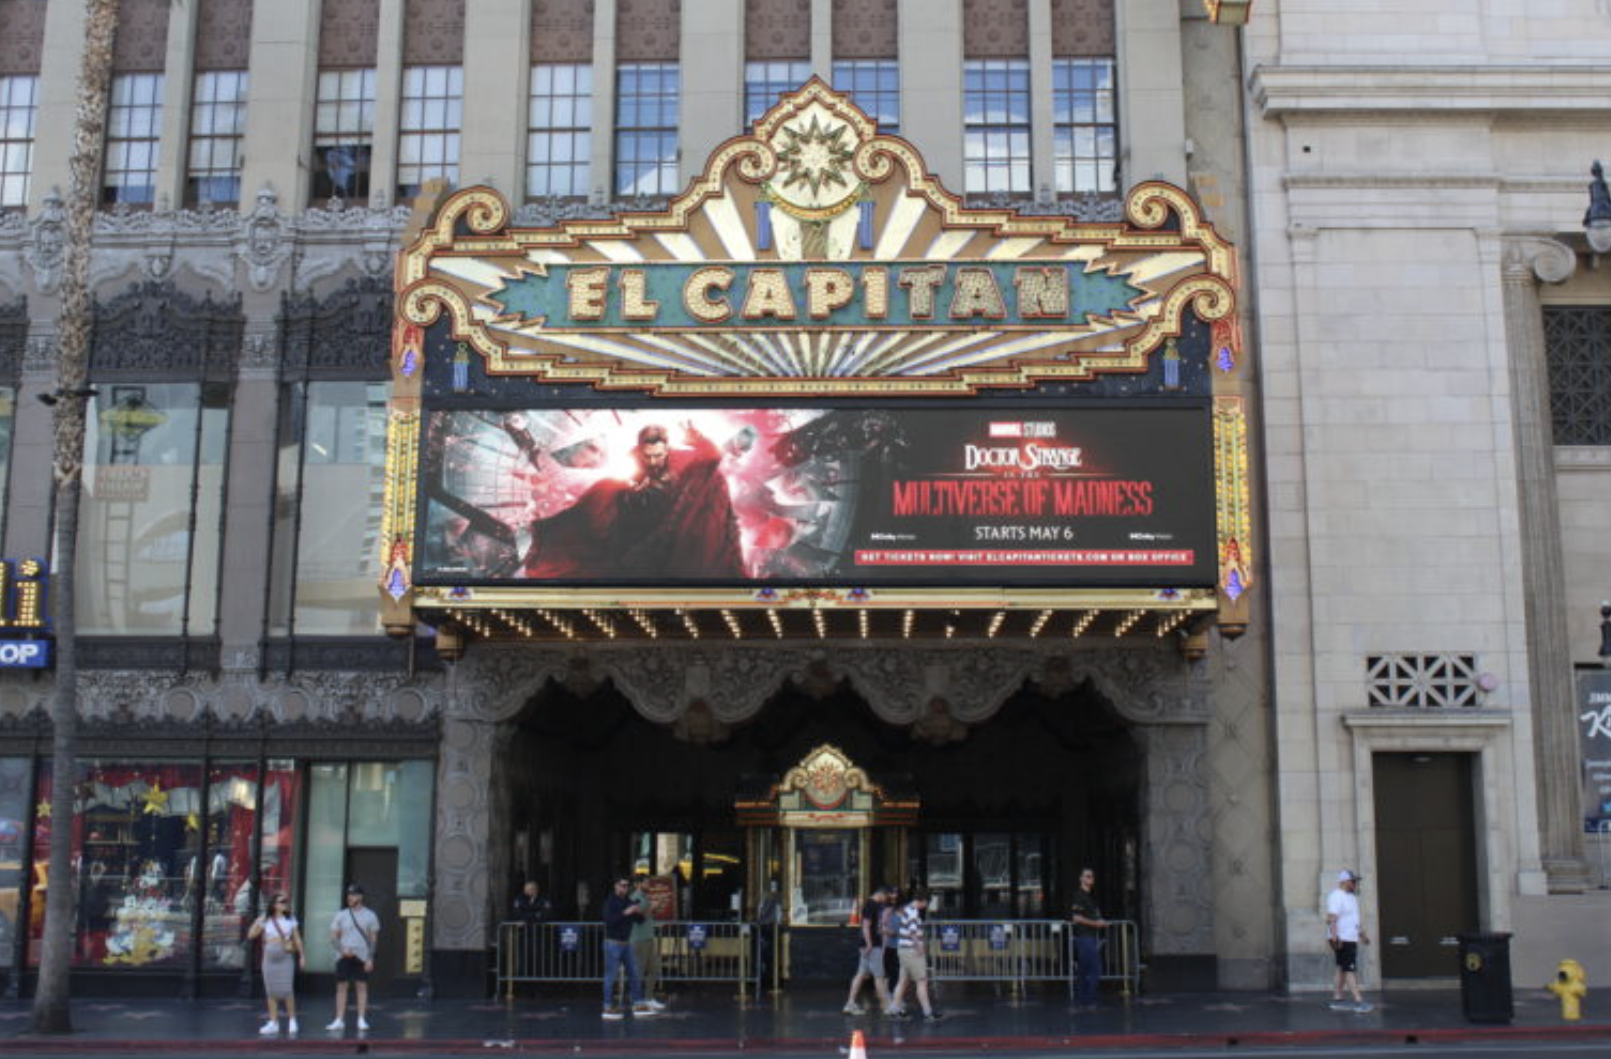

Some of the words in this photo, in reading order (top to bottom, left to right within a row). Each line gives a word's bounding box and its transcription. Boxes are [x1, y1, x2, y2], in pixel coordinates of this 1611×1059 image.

[566, 265, 660, 321] EL
[684, 263, 1070, 323] CAPITAN
[965, 443, 1020, 470] DOCTOR
[1019, 442, 1081, 470] STRANGE
[893, 480, 1020, 516] MULTIVERSE
[1023, 480, 1049, 516] OF
[1053, 480, 1154, 516] MADNESS
[975, 526, 1027, 541] STARTS
[1029, 526, 1060, 541] MAY
[1063, 526, 1074, 541] 6
